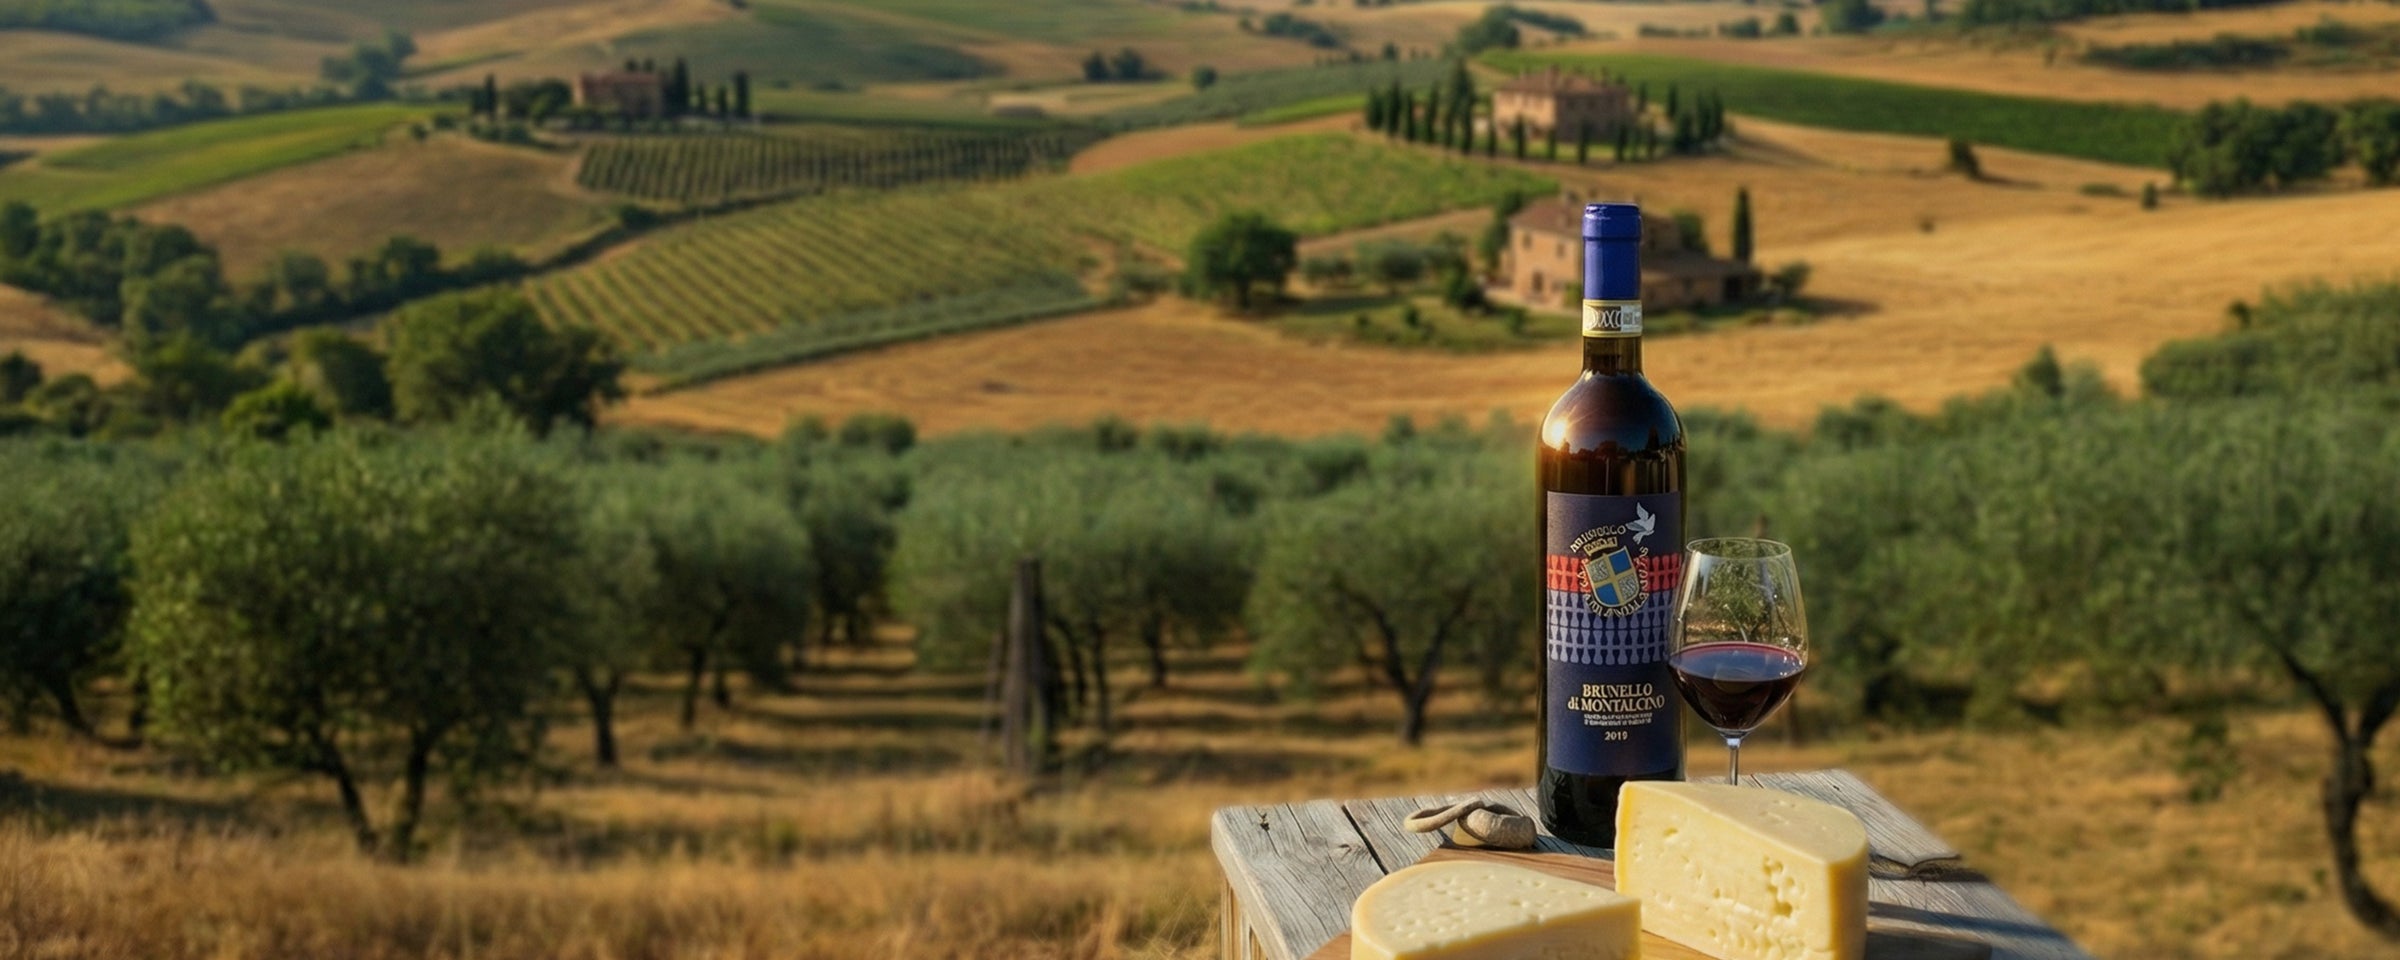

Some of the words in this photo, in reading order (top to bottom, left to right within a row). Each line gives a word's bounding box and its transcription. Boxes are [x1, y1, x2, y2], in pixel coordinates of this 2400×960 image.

[1582, 683, 1653, 698] BRUNELLO
[1567, 696, 1580, 711] di
[1581, 694, 1665, 713] MONTALCINO
[1604, 731, 1628, 741] 2019
